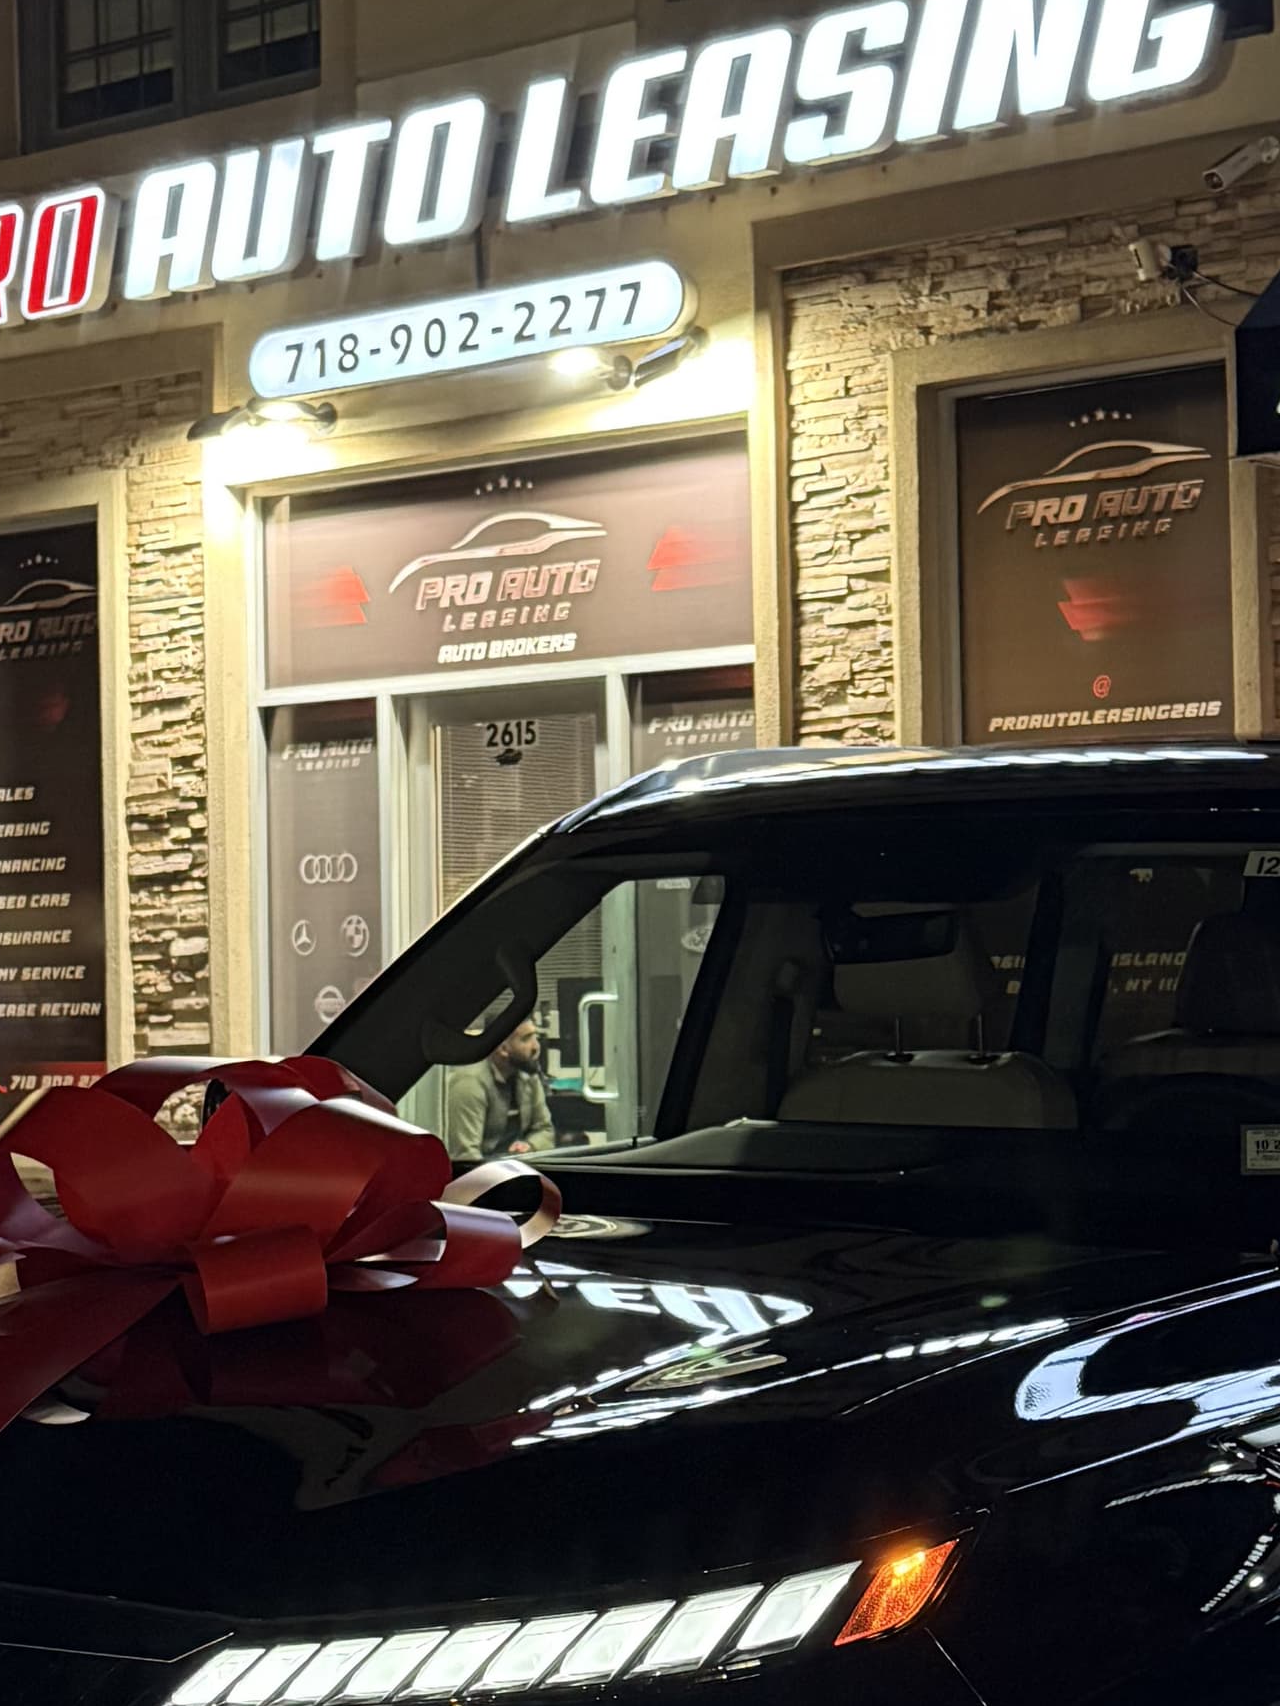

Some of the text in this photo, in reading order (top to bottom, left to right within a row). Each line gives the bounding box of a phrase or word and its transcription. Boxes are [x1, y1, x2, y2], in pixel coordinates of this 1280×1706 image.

[124, 96, 487, 301] AUTO
[283, 281, 644, 385] 718-902-2277
[1005, 479, 1205, 531] PRO AUTO
[1035, 518, 1173, 548] LEASING
[414, 559, 602, 611] PRO AUTO
[441, 601, 573, 633] LEASING
[437, 633, 579, 664] AUTO BROKERS
[1092, 674, 1111, 698] @
[988, 701, 1223, 732] PROAUTOLEASING2615
[485, 720, 536, 748] 2615
[29, 893, 71, 909] CARS
[21, 965, 86, 981] SERVICE
[40, 1002, 102, 1017] RETURN
